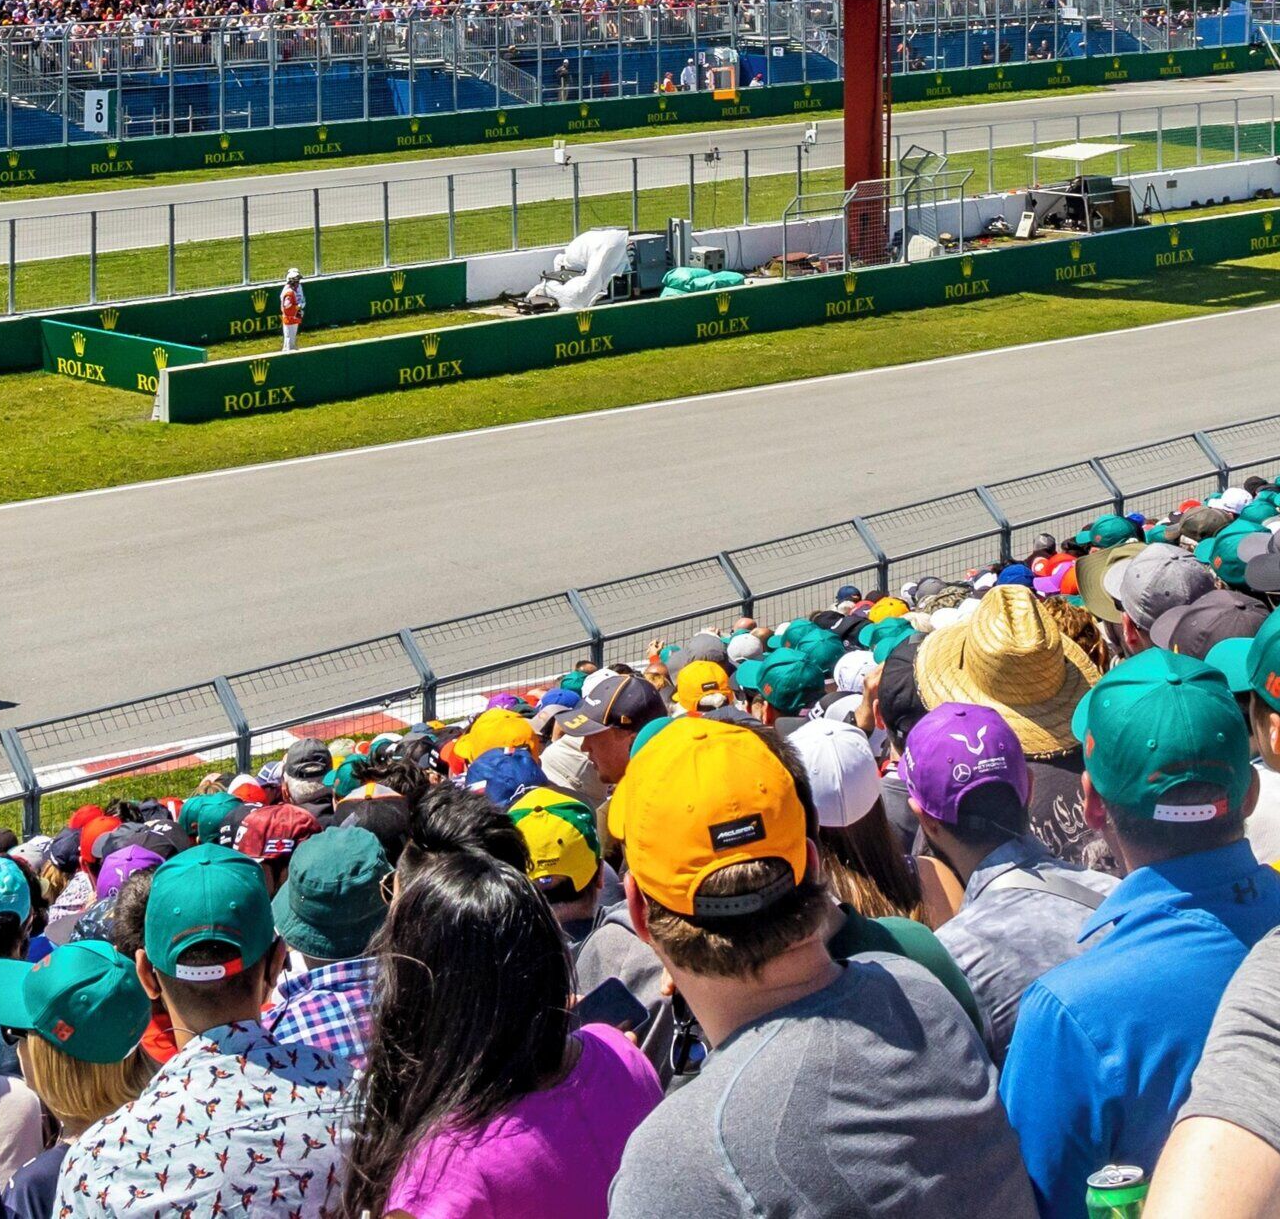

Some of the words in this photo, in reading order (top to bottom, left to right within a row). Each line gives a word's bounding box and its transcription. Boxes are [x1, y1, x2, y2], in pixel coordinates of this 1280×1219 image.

[1105, 71, 1127, 79] ROLEX
[1160, 66, 1181, 74] ROLEX
[988, 81, 1011, 90] ROLEX
[1048, 76, 1070, 84] ROLEX
[927, 87, 951, 95] ROLEX
[794, 100, 821, 108] ROLEX
[648, 112, 677, 122] ROLEX
[722, 106, 750, 116] ROLEX
[569, 119, 599, 129] ROLEX
[485, 126, 518, 138] ROLEX
[397, 134, 432, 145] ROLEX
[304, 143, 340, 155] ROLEX
[205, 151, 244, 164] ROLEX
[91, 161, 132, 173] ROLEX
[1156, 249, 1193, 266] ROLEX
[1056, 263, 1096, 280] ROLEX
[945, 280, 989, 298] ROLEX
[371, 295, 425, 315] ROLEX
[826, 297, 874, 316] ROLEX
[697, 318, 748, 337] ROLEX
[555, 336, 612, 358] ROLEX
[57, 357, 105, 382] ROLEX
[400, 360, 462, 384] ROLEX
[225, 386, 294, 411] ROLEX
